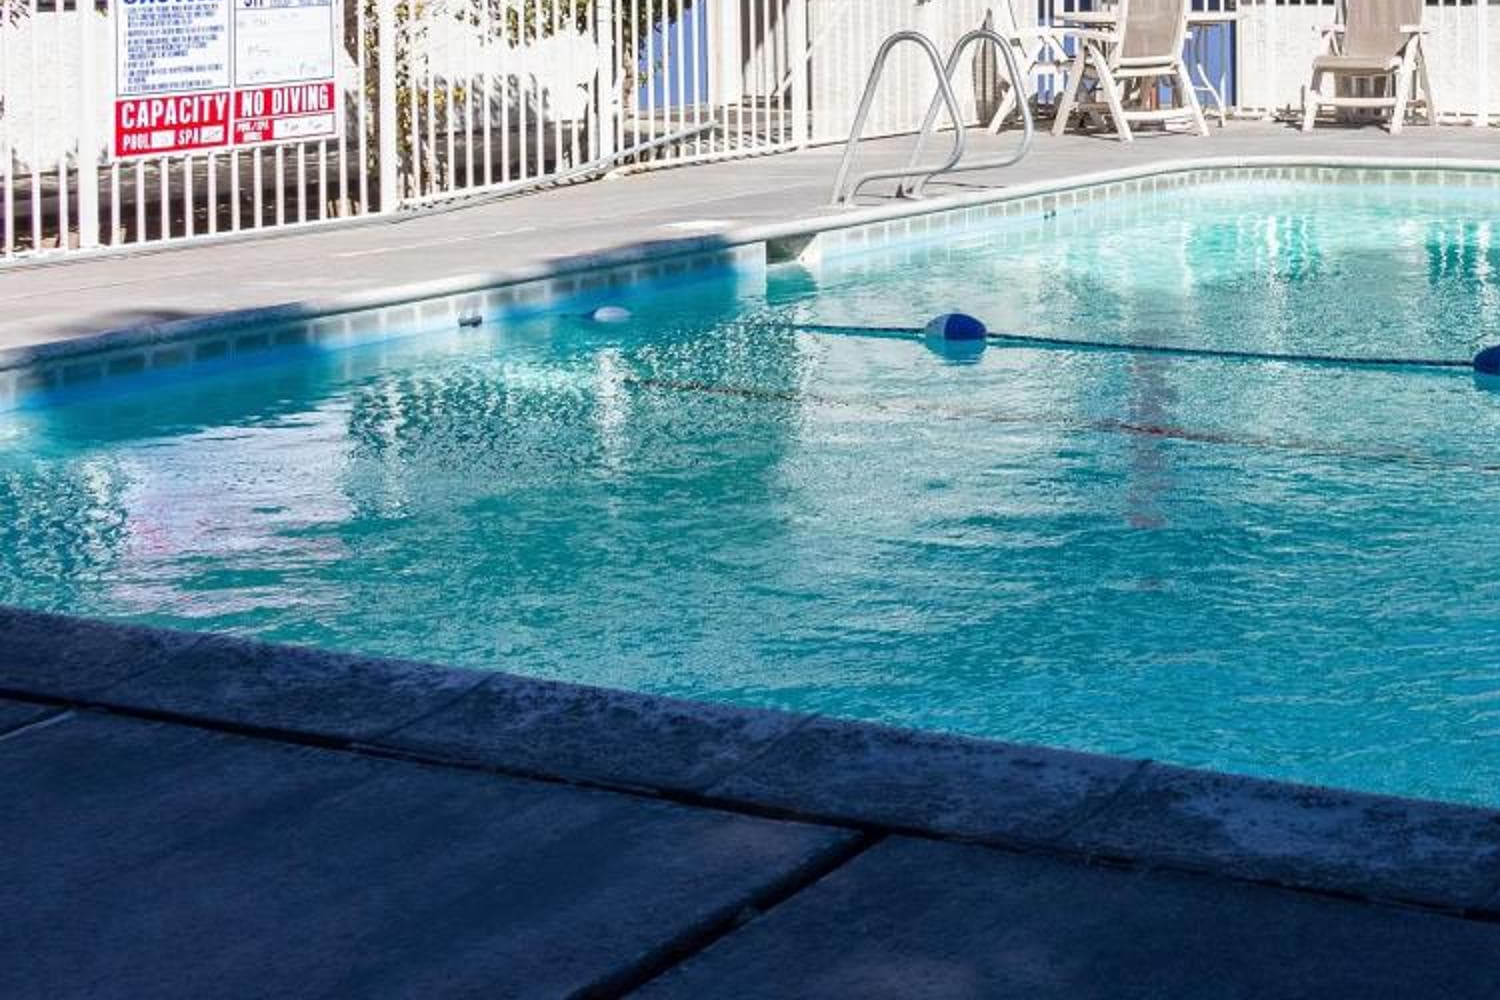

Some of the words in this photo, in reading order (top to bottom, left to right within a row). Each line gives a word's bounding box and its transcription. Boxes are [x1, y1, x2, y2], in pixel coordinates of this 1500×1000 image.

[122, 94, 228, 128] CAPACITY
[241, 92, 264, 116] NO
[272, 86, 328, 113] DIVING
[123, 132, 151, 151] POOL
[178, 129, 199, 145] SPA
